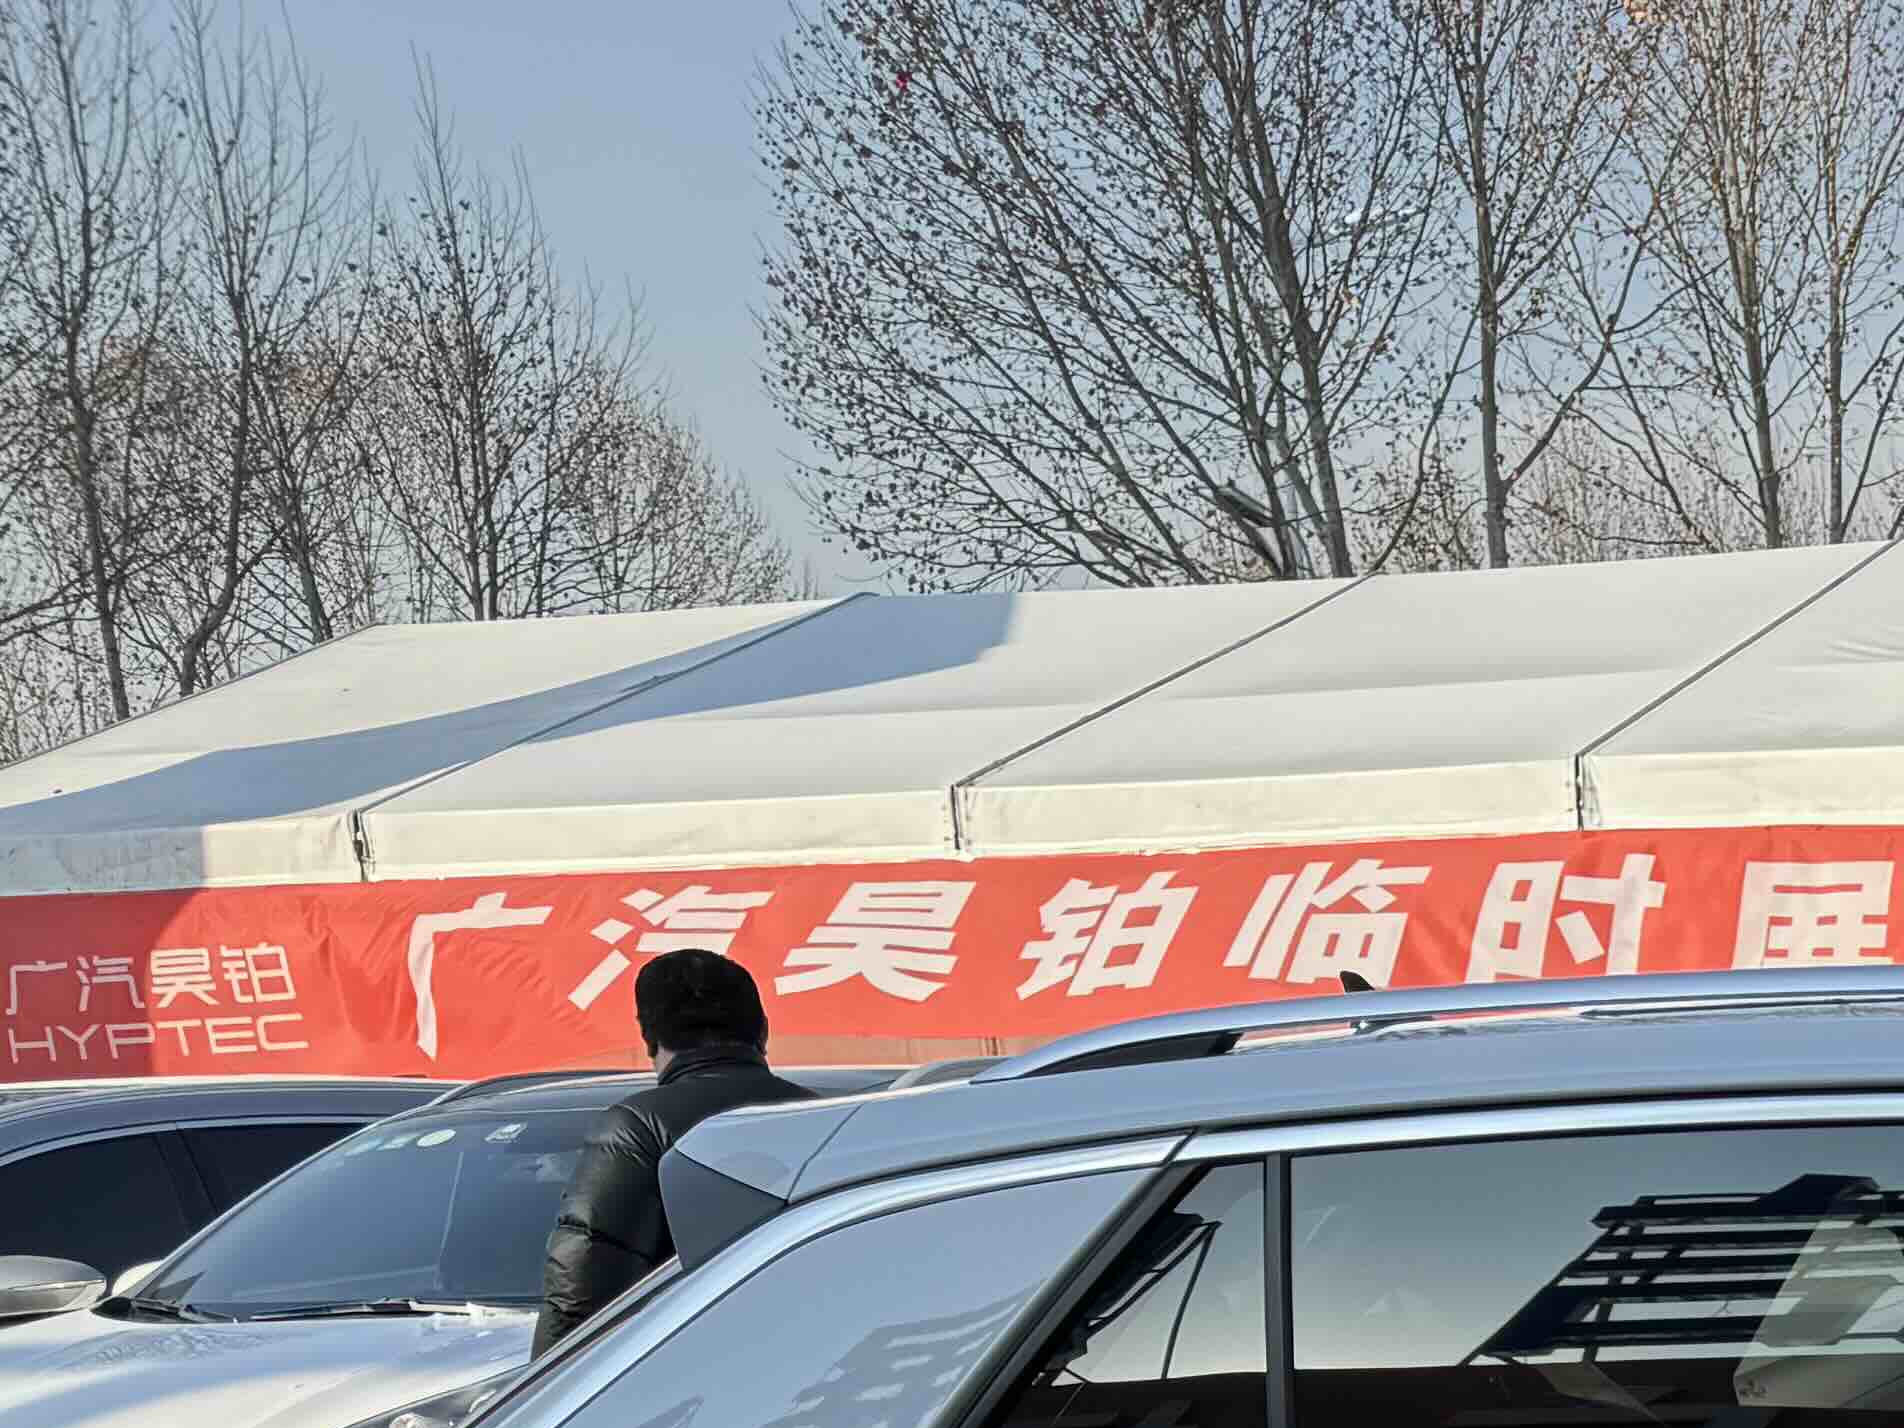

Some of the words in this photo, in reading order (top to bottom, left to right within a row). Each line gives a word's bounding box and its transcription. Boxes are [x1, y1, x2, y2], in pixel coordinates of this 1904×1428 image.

[5, 941, 296, 1014] 广汽昊铂
[7, 1012, 310, 1064] HYPTEC
